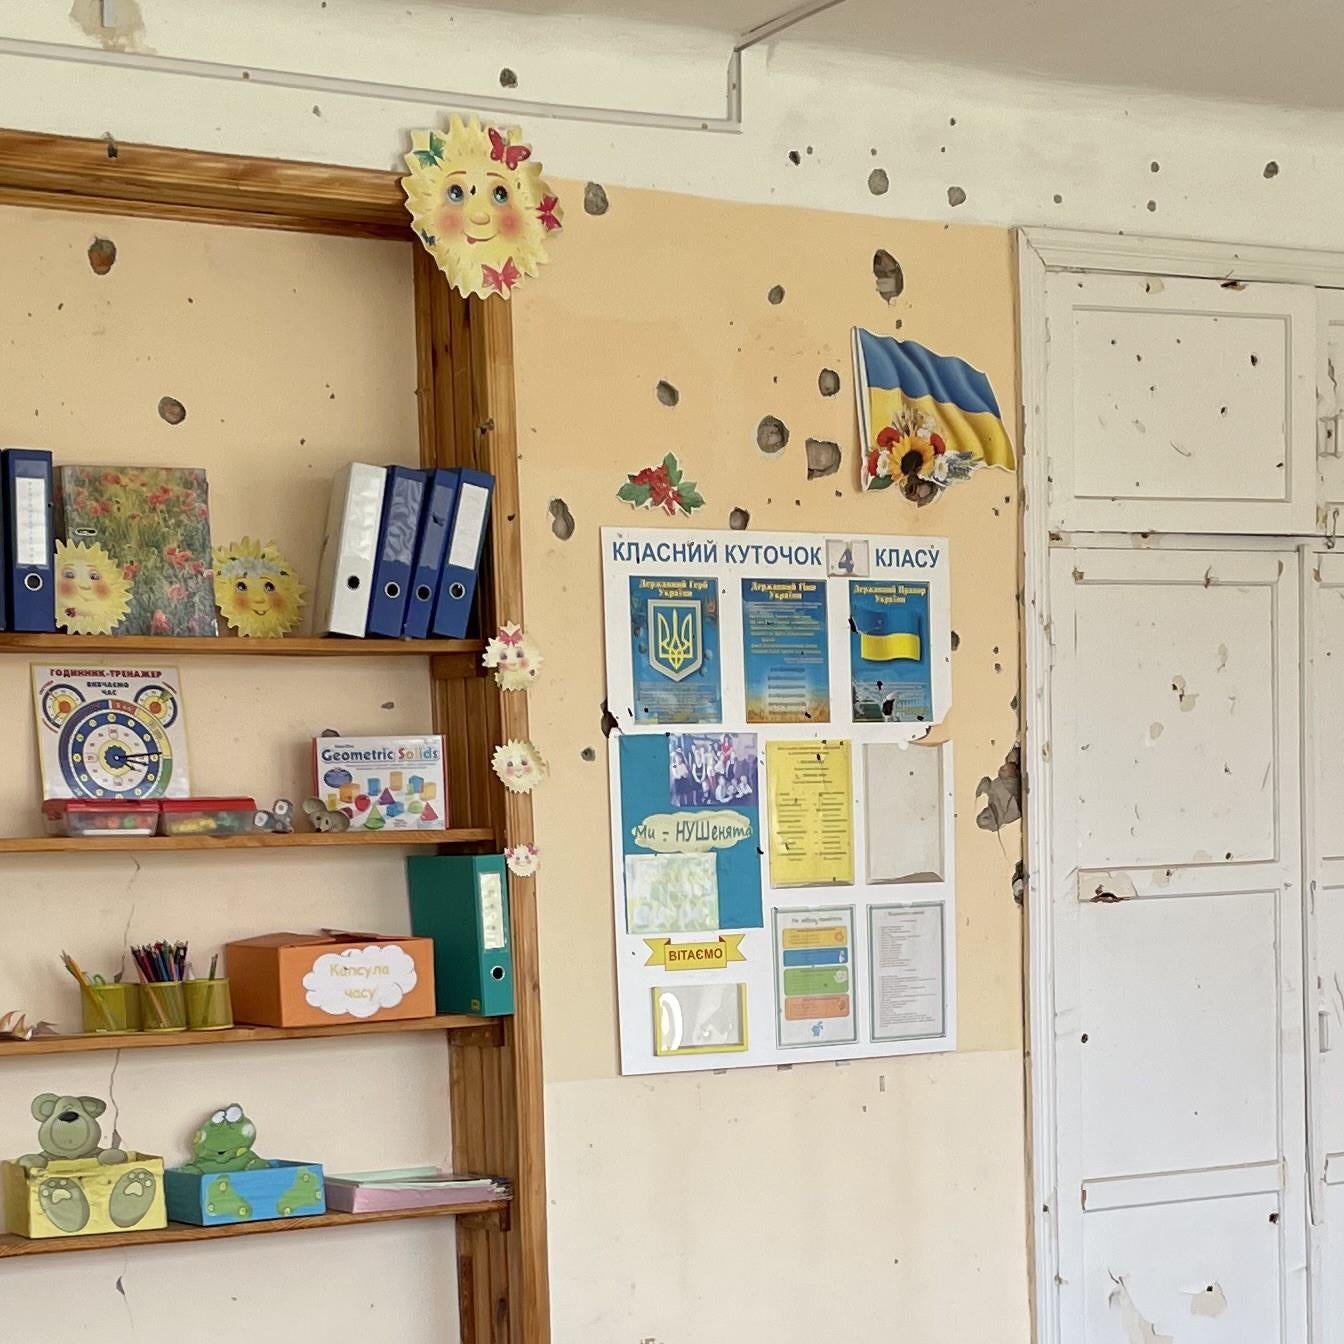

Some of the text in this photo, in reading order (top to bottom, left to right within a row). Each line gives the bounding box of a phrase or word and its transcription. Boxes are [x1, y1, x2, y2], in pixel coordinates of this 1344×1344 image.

[613, 540, 940, 573] КЛАСНИЙ КУТОЧОК 4 КЛАСУ
[50, 669, 162, 677] ГОДИННИК-ТРЕНАЖЕР
[321, 747, 439, 761] Geometric Solids
[668, 948, 723, 961] ВІТАЄМО
[329, 964, 390, 978] Капсула
